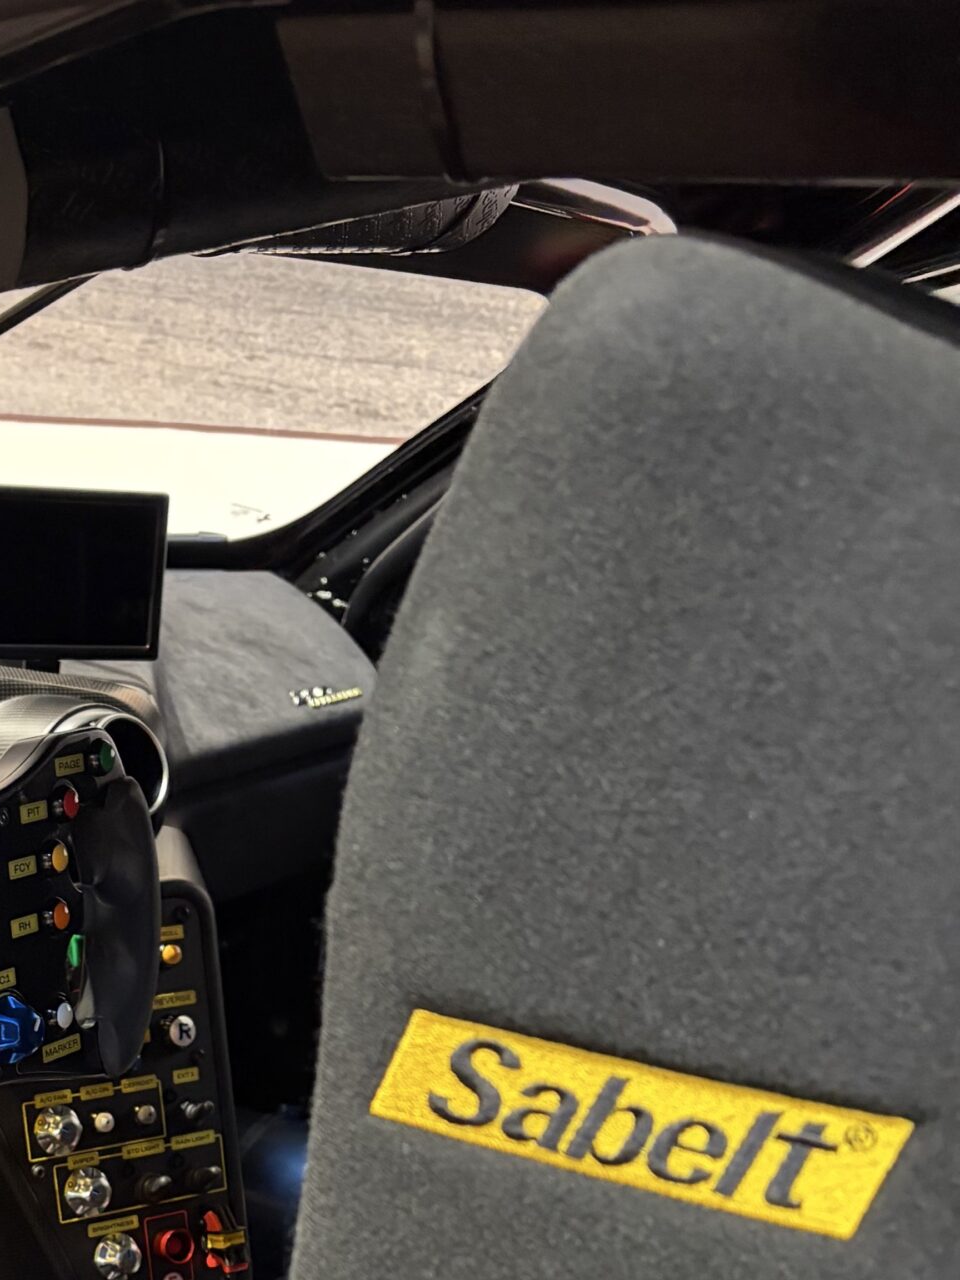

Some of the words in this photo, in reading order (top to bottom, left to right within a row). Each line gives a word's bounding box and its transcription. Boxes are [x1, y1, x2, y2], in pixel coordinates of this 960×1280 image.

[58, 758, 81, 772] PAGE
[27, 806, 41, 818] PIT
[13, 861, 32, 874] FCY
[18, 920, 32, 932] RH
[179, 1023, 191, 1041] R
[44, 1038, 79, 1058] MARKER
